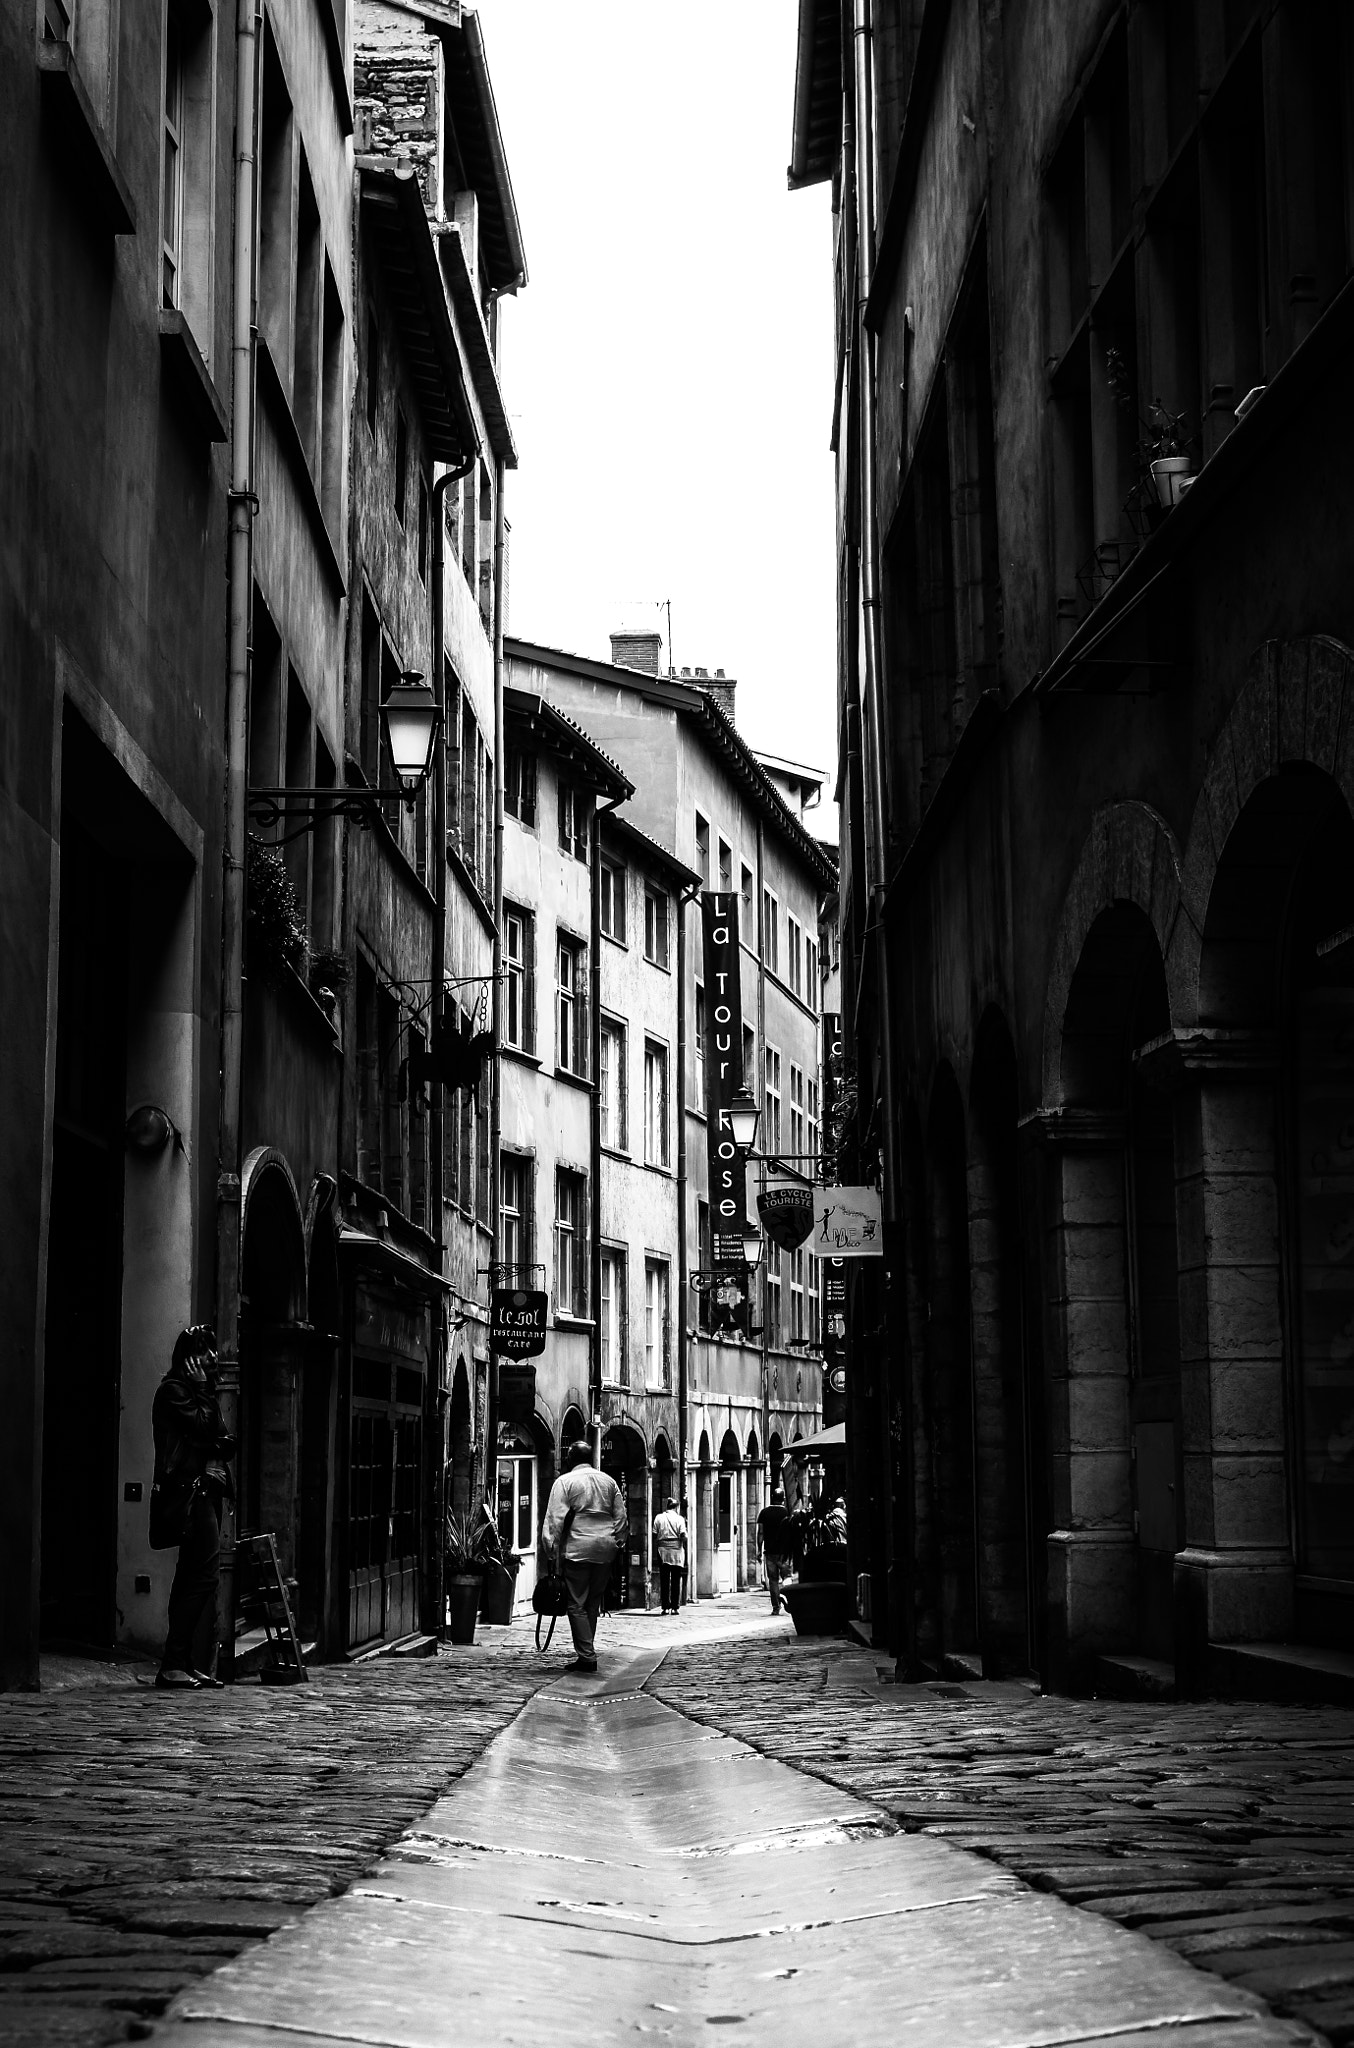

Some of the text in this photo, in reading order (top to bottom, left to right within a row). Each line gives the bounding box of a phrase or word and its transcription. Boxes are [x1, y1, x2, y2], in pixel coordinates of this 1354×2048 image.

[713, 895, 736, 1216] La Tour Rose
[765, 1189, 812, 1201] LE CYCLO
[763, 1196, 812, 1208] TOURISTE
